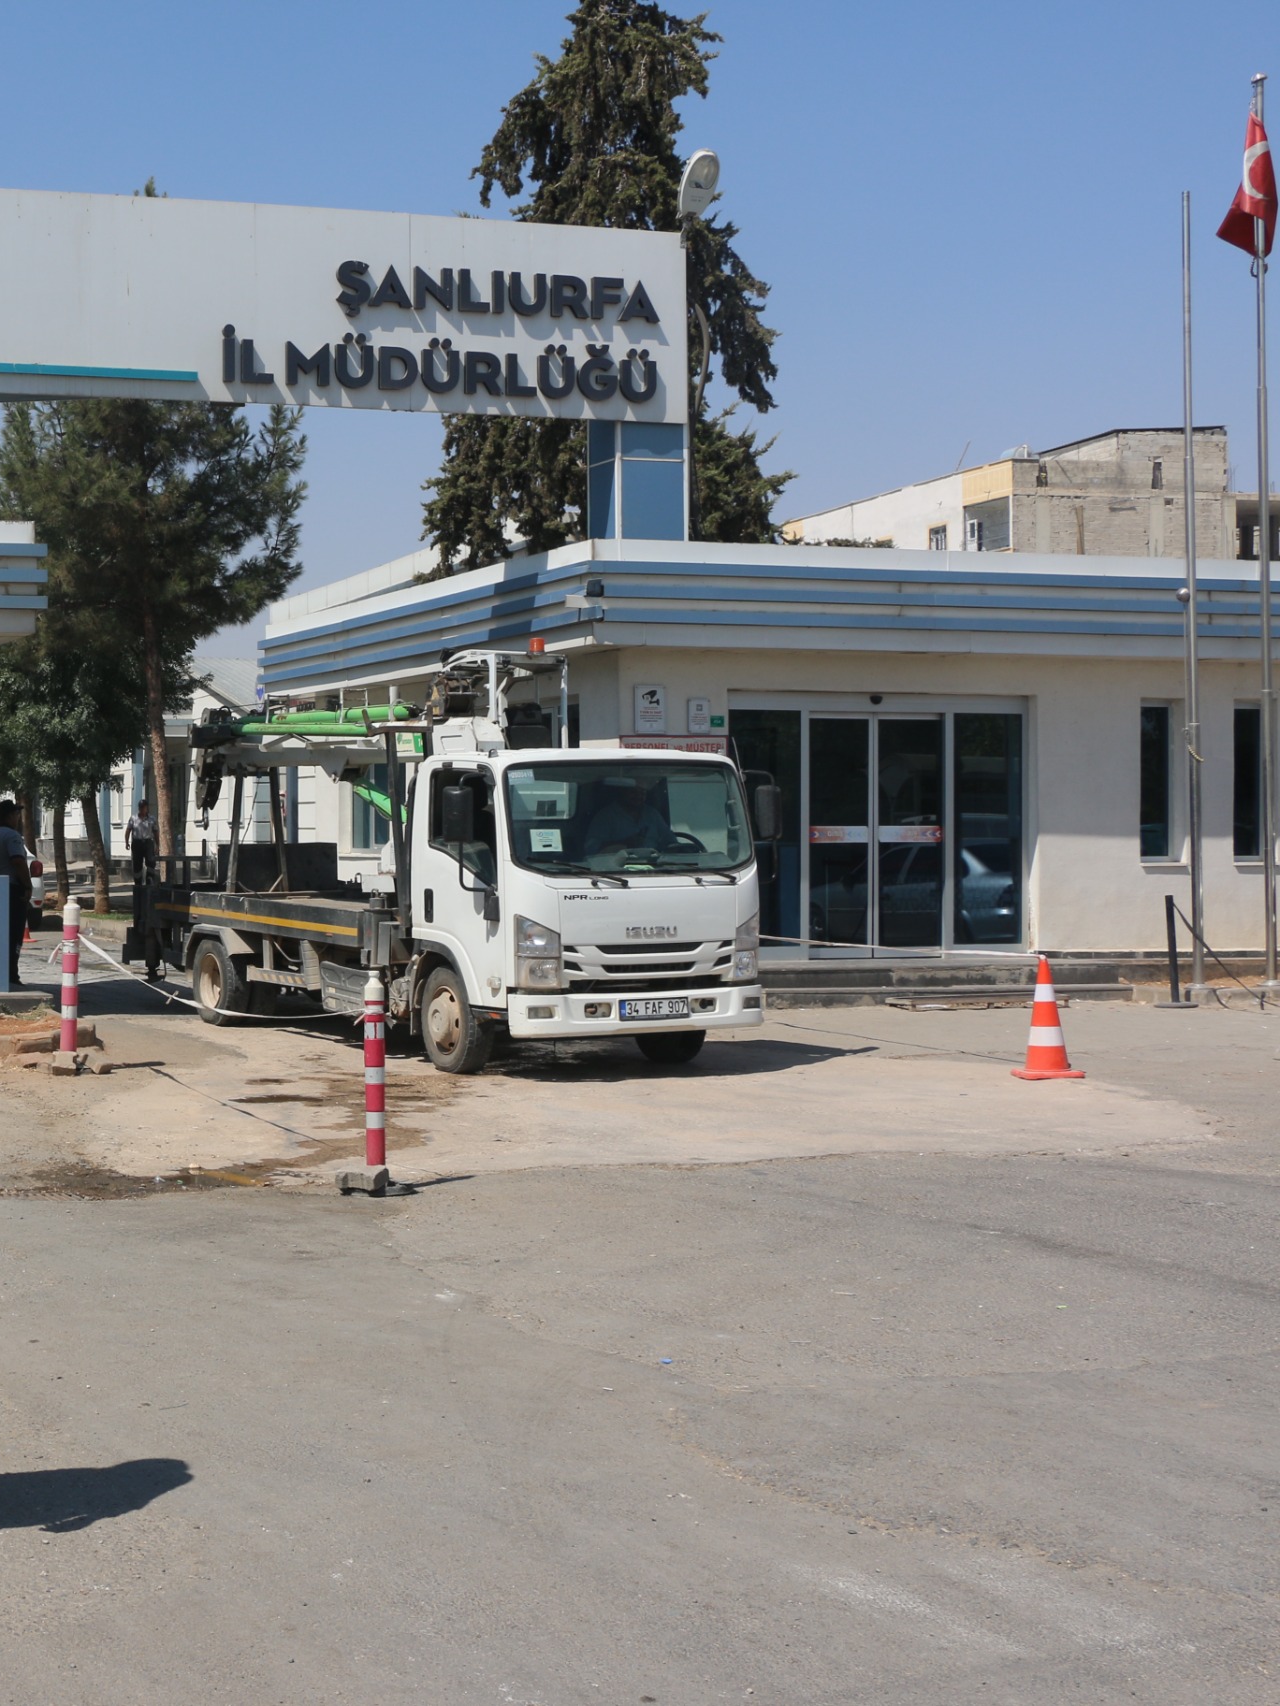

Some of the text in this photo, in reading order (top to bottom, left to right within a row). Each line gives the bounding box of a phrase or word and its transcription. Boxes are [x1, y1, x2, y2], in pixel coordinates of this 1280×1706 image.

[335, 259, 660, 324] ŞANLIURFA
[222, 324, 658, 403] İL MÜDÜRLÜĞÜ
[625, 926, 678, 939] ISUZU
[626, 1000, 686, 1015] 34 FAF 907
